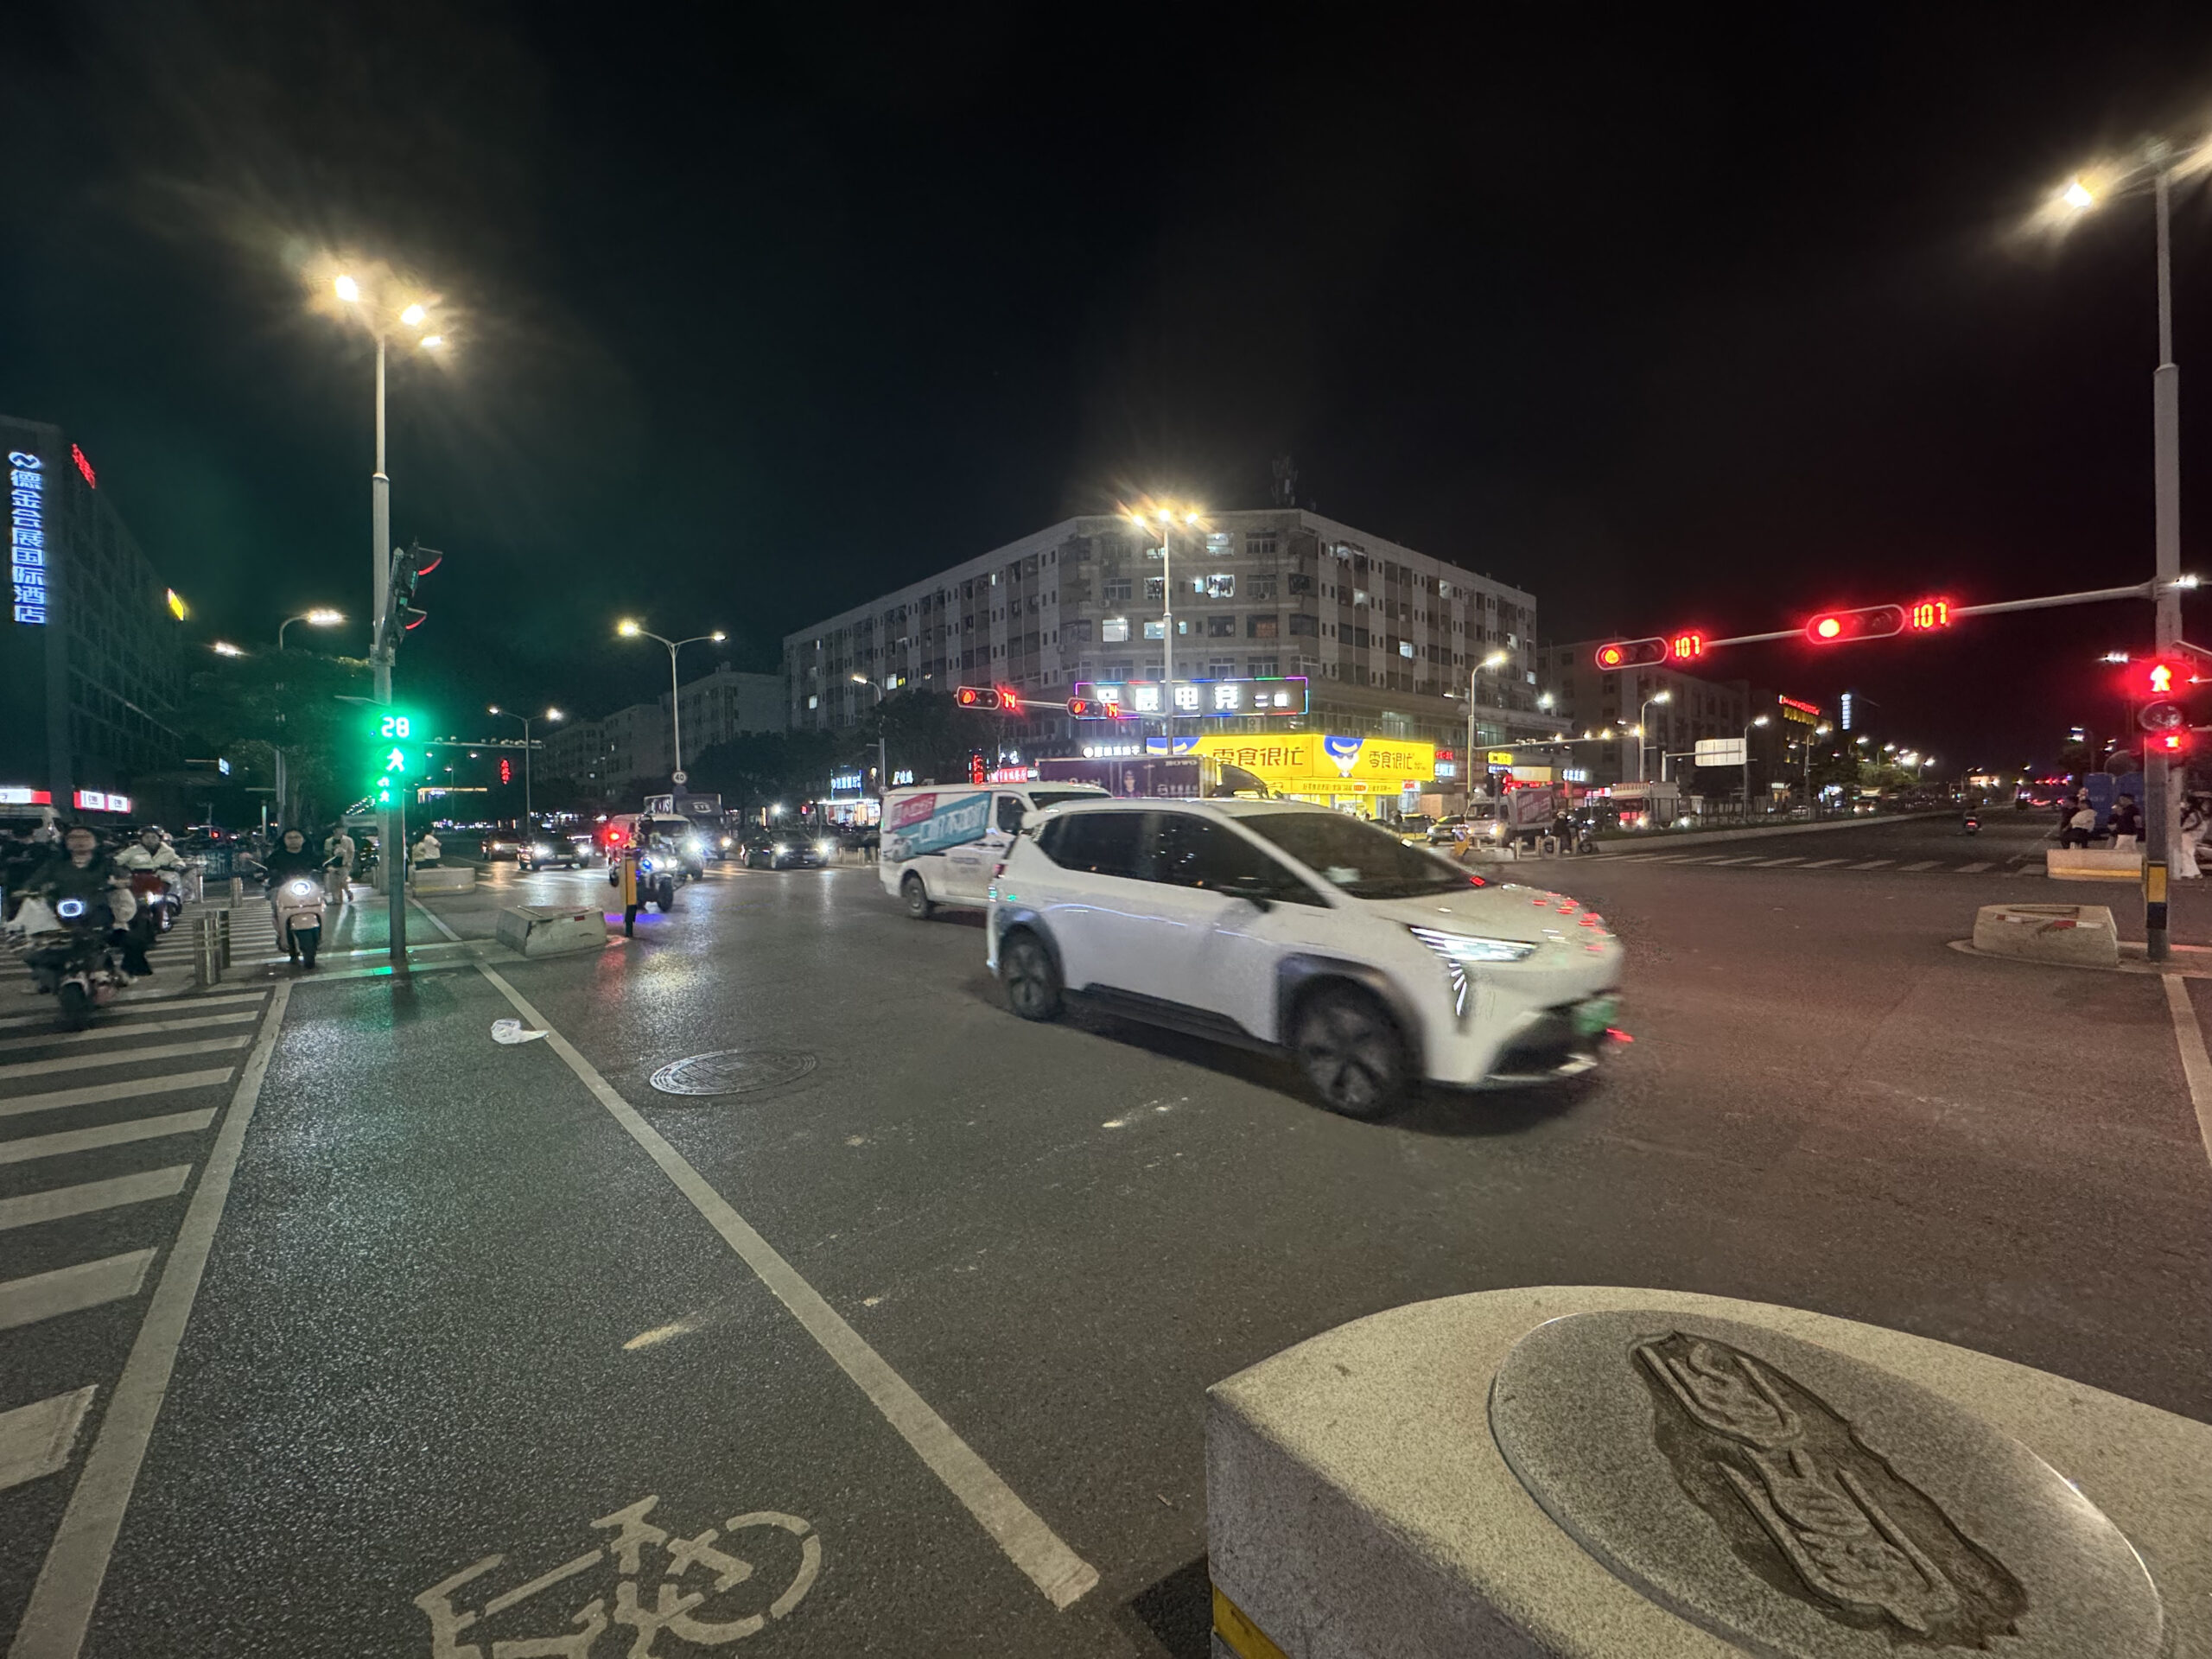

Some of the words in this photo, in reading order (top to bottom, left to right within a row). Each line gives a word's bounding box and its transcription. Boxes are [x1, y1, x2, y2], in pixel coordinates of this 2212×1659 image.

[10, 469, 46, 624] 德金会展国际酒店
[1913, 602, 1947, 628] 107
[1675, 635, 1700, 658] 107
[1003, 692, 1016, 708] 74
[1107, 703, 1118, 717] 74
[381, 716, 410, 738] 28
[1213, 747, 1305, 766] 零食很忙
[1369, 751, 1413, 770] 零食很忙
